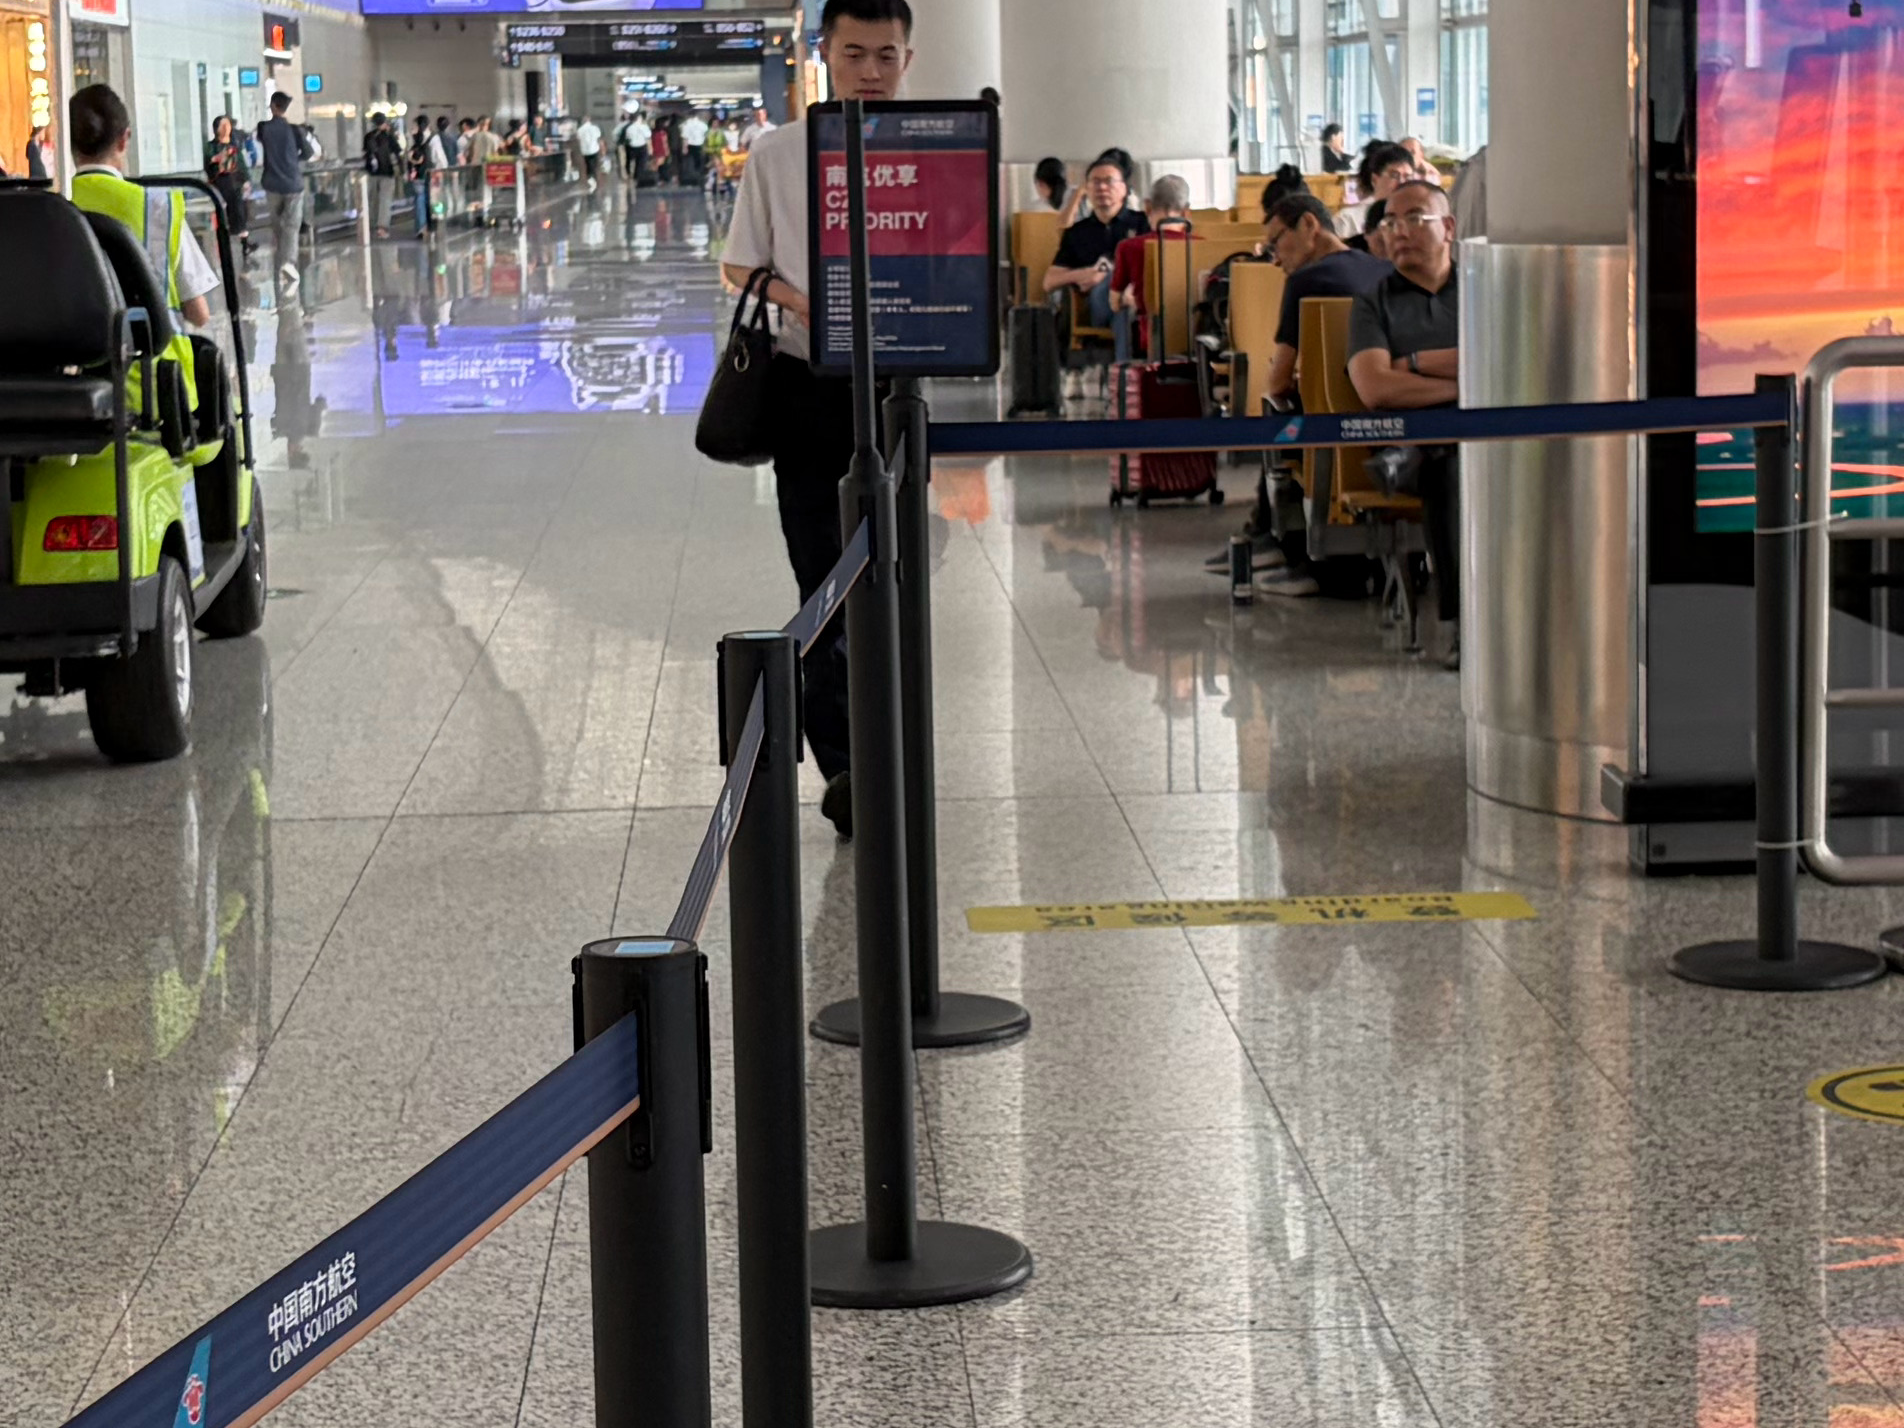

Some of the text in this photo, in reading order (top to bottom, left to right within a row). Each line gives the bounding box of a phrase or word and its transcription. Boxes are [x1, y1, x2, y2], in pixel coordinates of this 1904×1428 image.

[826, 212, 929, 230] PRORITY
[267, 1250, 356, 1341] 中国南方航空
[270, 1291, 358, 1374] CHINA SOUTHERN
